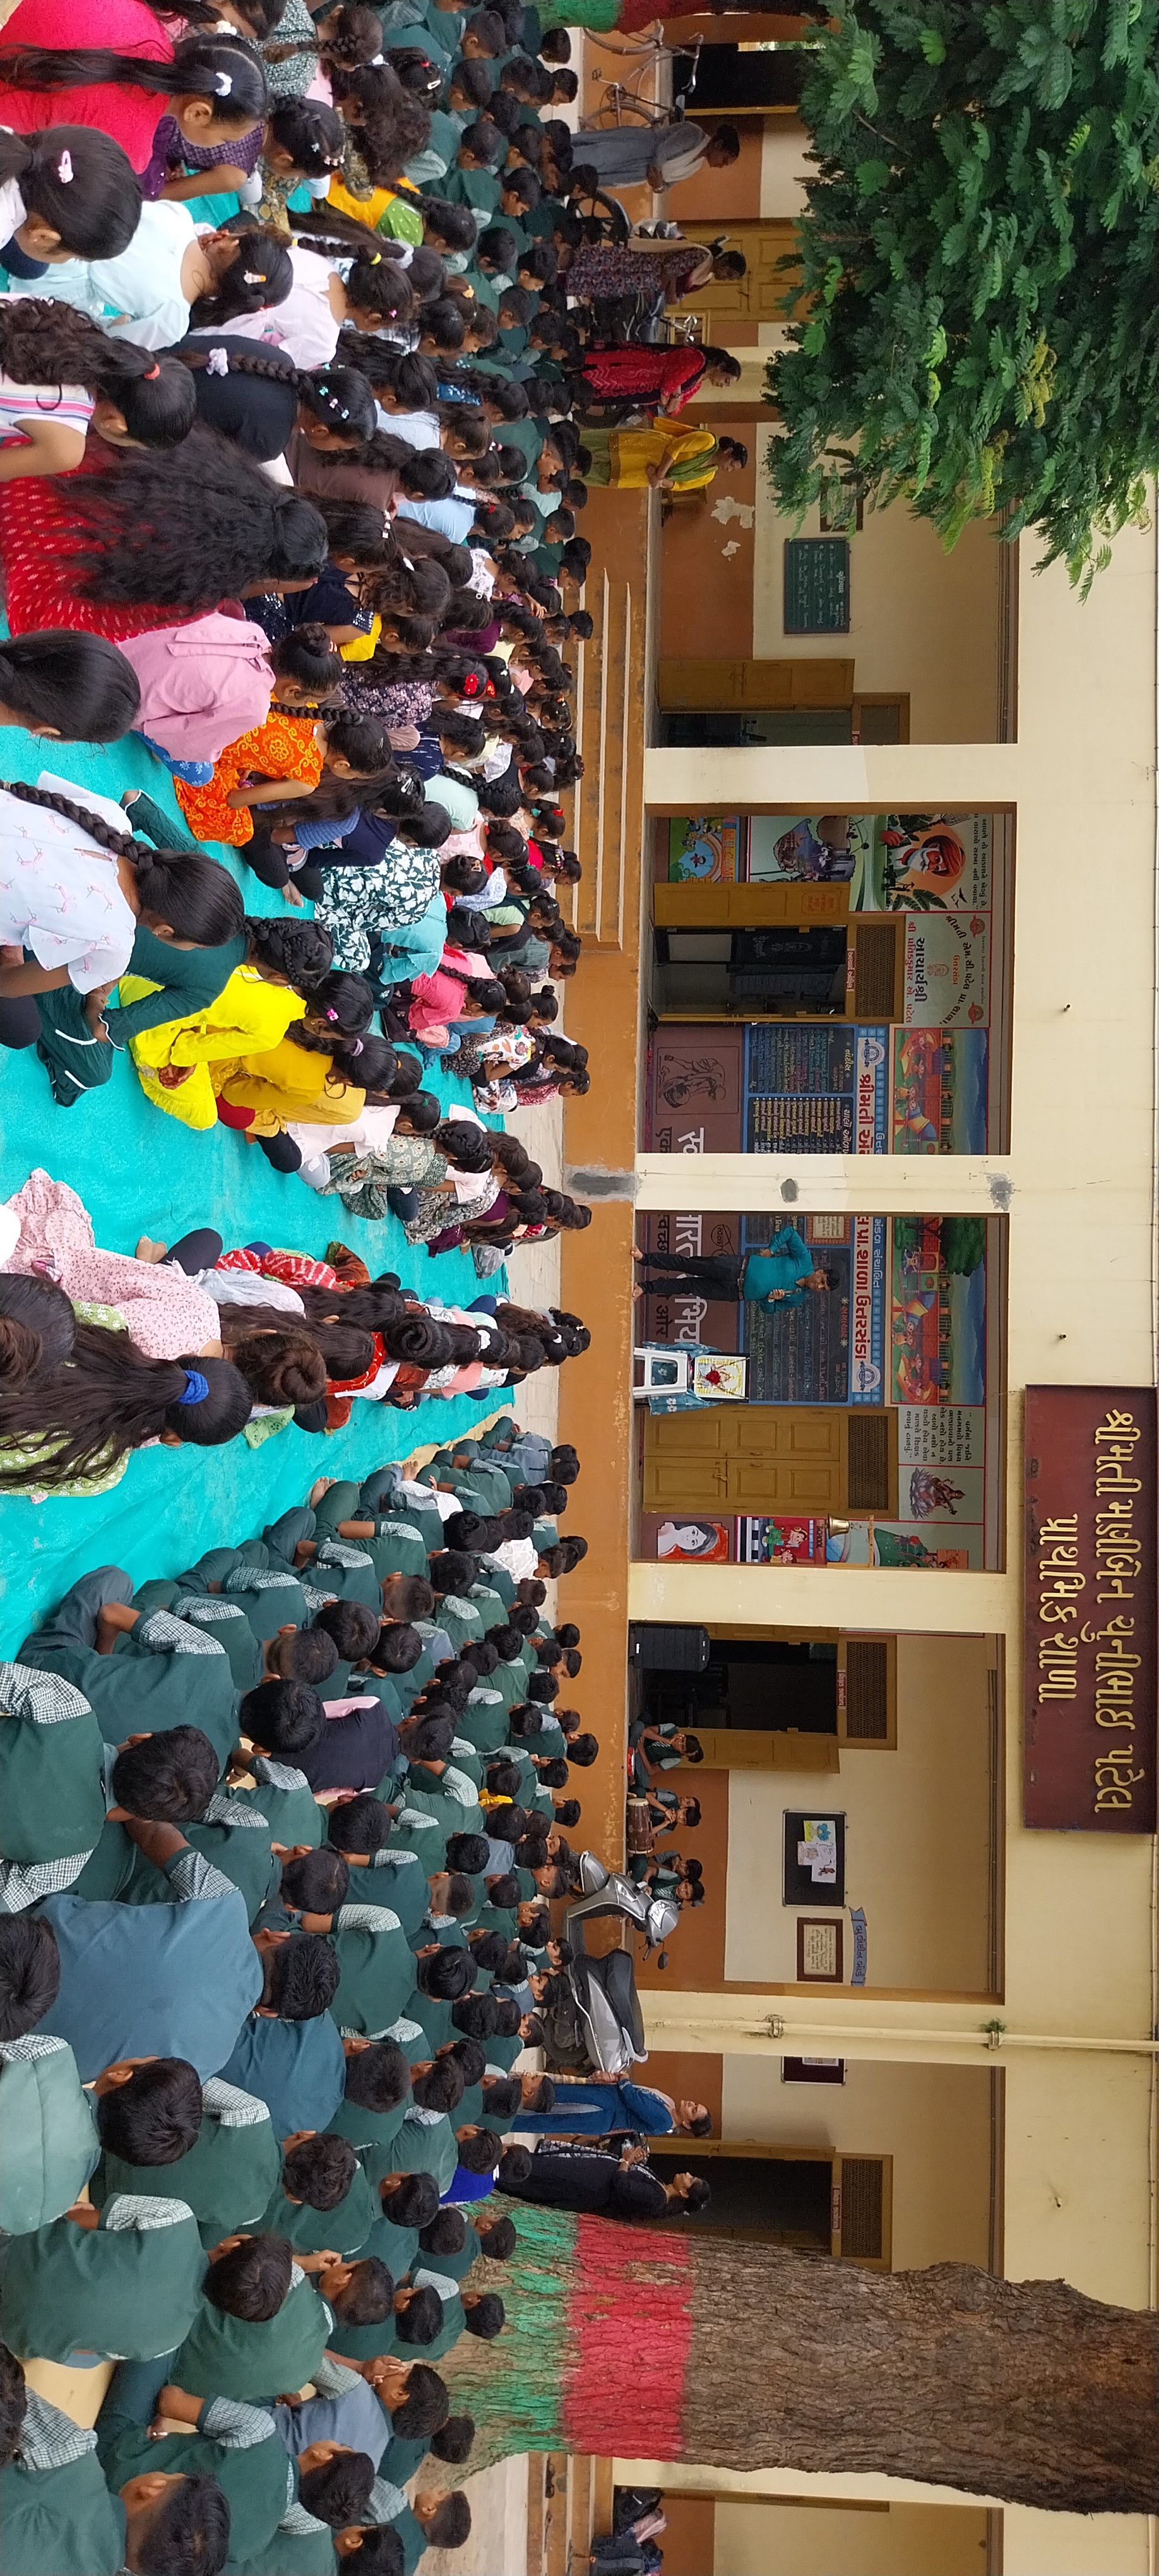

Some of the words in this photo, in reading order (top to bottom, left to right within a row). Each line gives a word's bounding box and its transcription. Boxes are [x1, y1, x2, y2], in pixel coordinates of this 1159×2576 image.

[908, 921, 917, 932] શ્રી
[914, 937, 928, 1003] આચાર્યશ્રી
[905, 1003, 914, 1023] પટેલ
[859, 1073, 875, 1125] શ્રીમતી
[874, 1219, 883, 1244] મંડળ
[872, 1249, 883, 1288] સંચાલિત
[655, 1304, 673, 1338] ओर
[948, 1450, 953, 1462] પણ
[1095, 1409, 1141, 1496] શ્રીમતી
[1038, 1513, 1085, 1624] પ્રાથમિક
[1095, 1499, 1142, 1604] મણીબેન
[1038, 1633, 1079, 1703] શાળા
[1094, 1744, 1144, 1814] પટેલ
